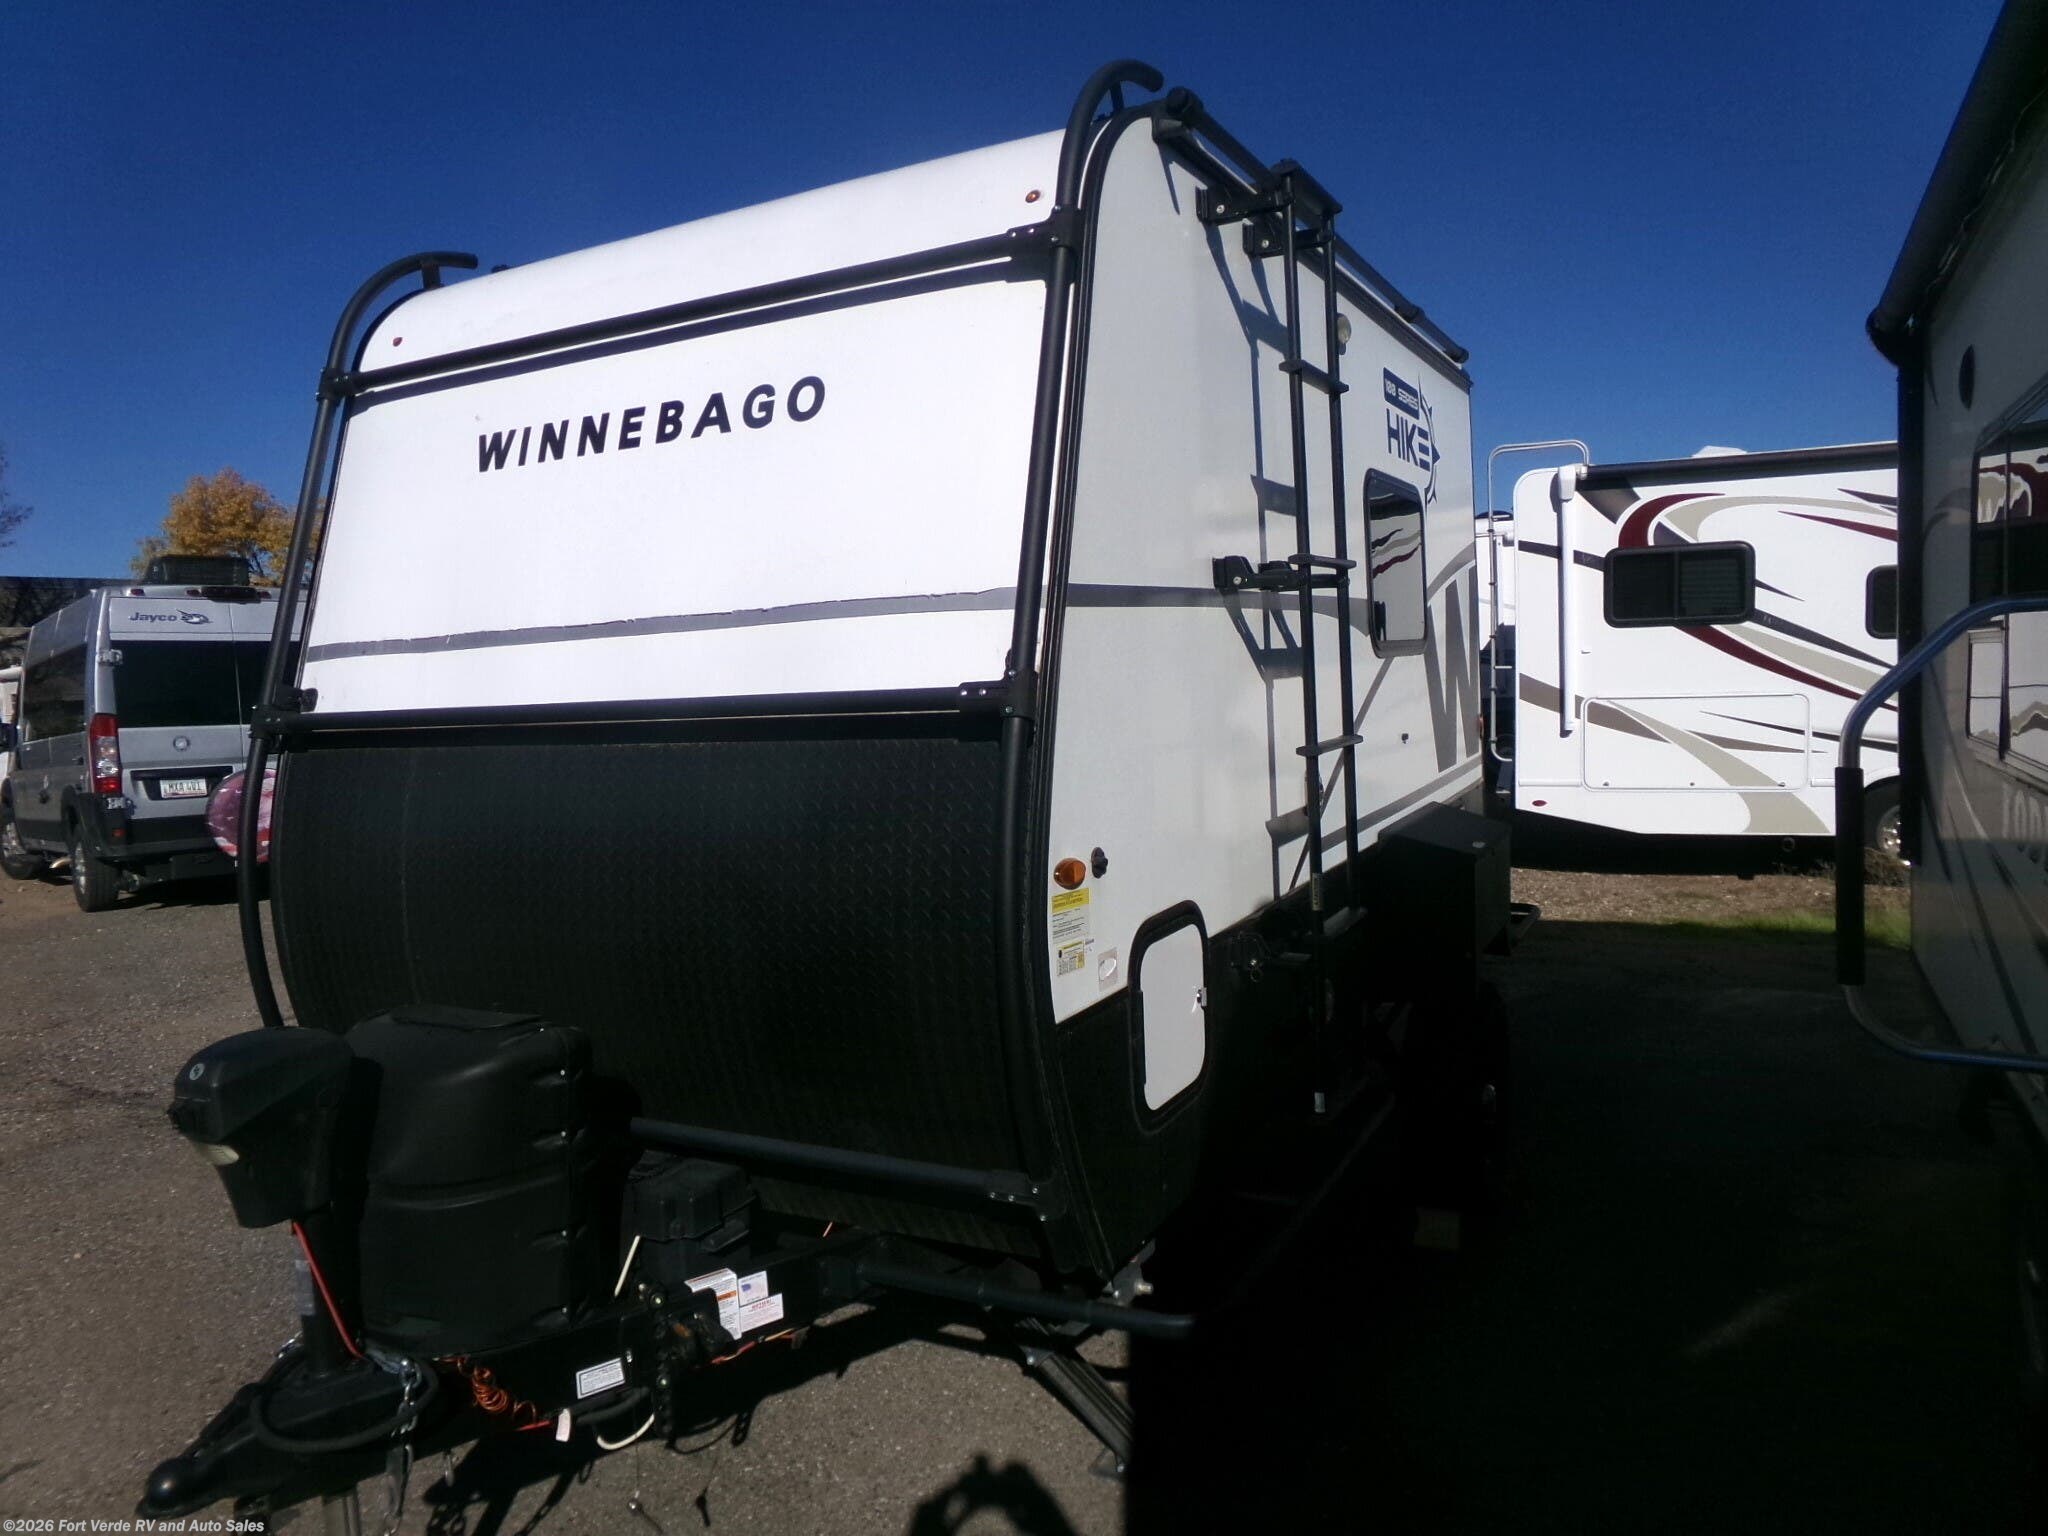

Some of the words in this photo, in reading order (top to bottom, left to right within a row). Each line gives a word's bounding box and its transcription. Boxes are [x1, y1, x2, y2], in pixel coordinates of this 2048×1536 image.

[478, 375, 826, 473] WINNEBAGO
[1386, 408, 1430, 472] HIKE
[129, 612, 178, 623] Jayco
